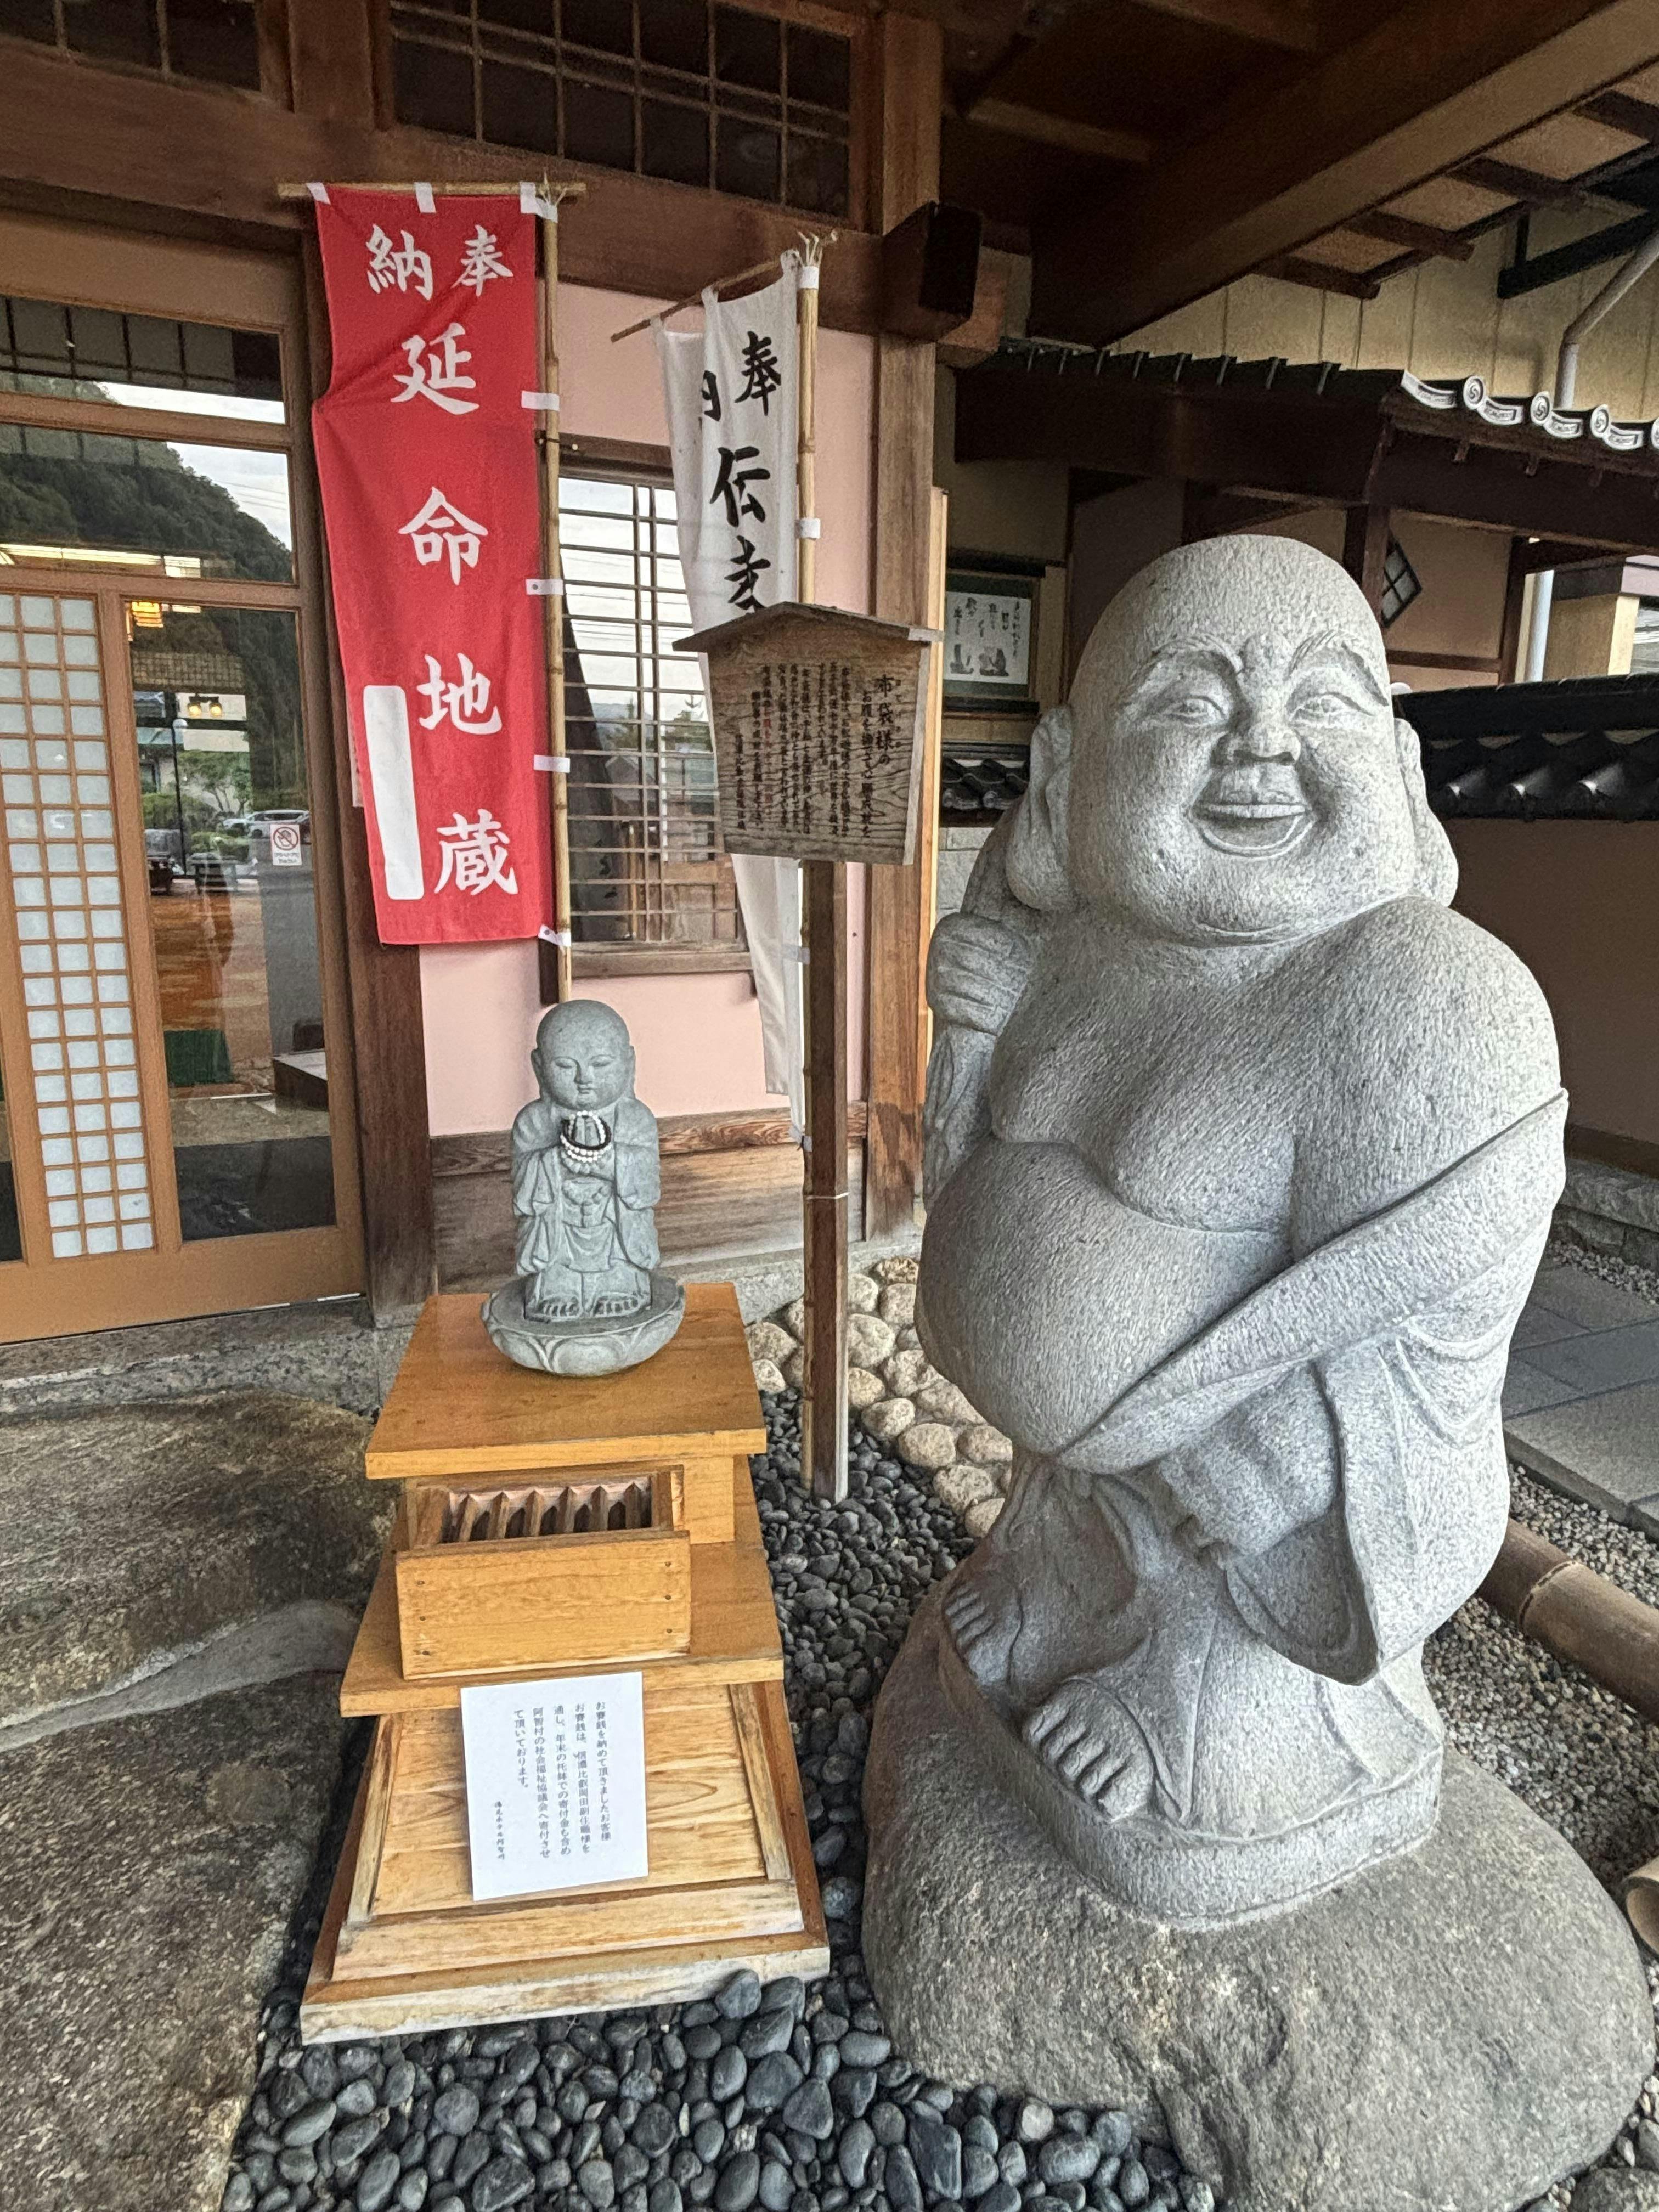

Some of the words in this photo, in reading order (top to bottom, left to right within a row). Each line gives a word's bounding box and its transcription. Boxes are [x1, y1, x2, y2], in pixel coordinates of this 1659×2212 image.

[365, 224, 513, 300] 奉納
[390, 323, 518, 895] 延命地蔵
